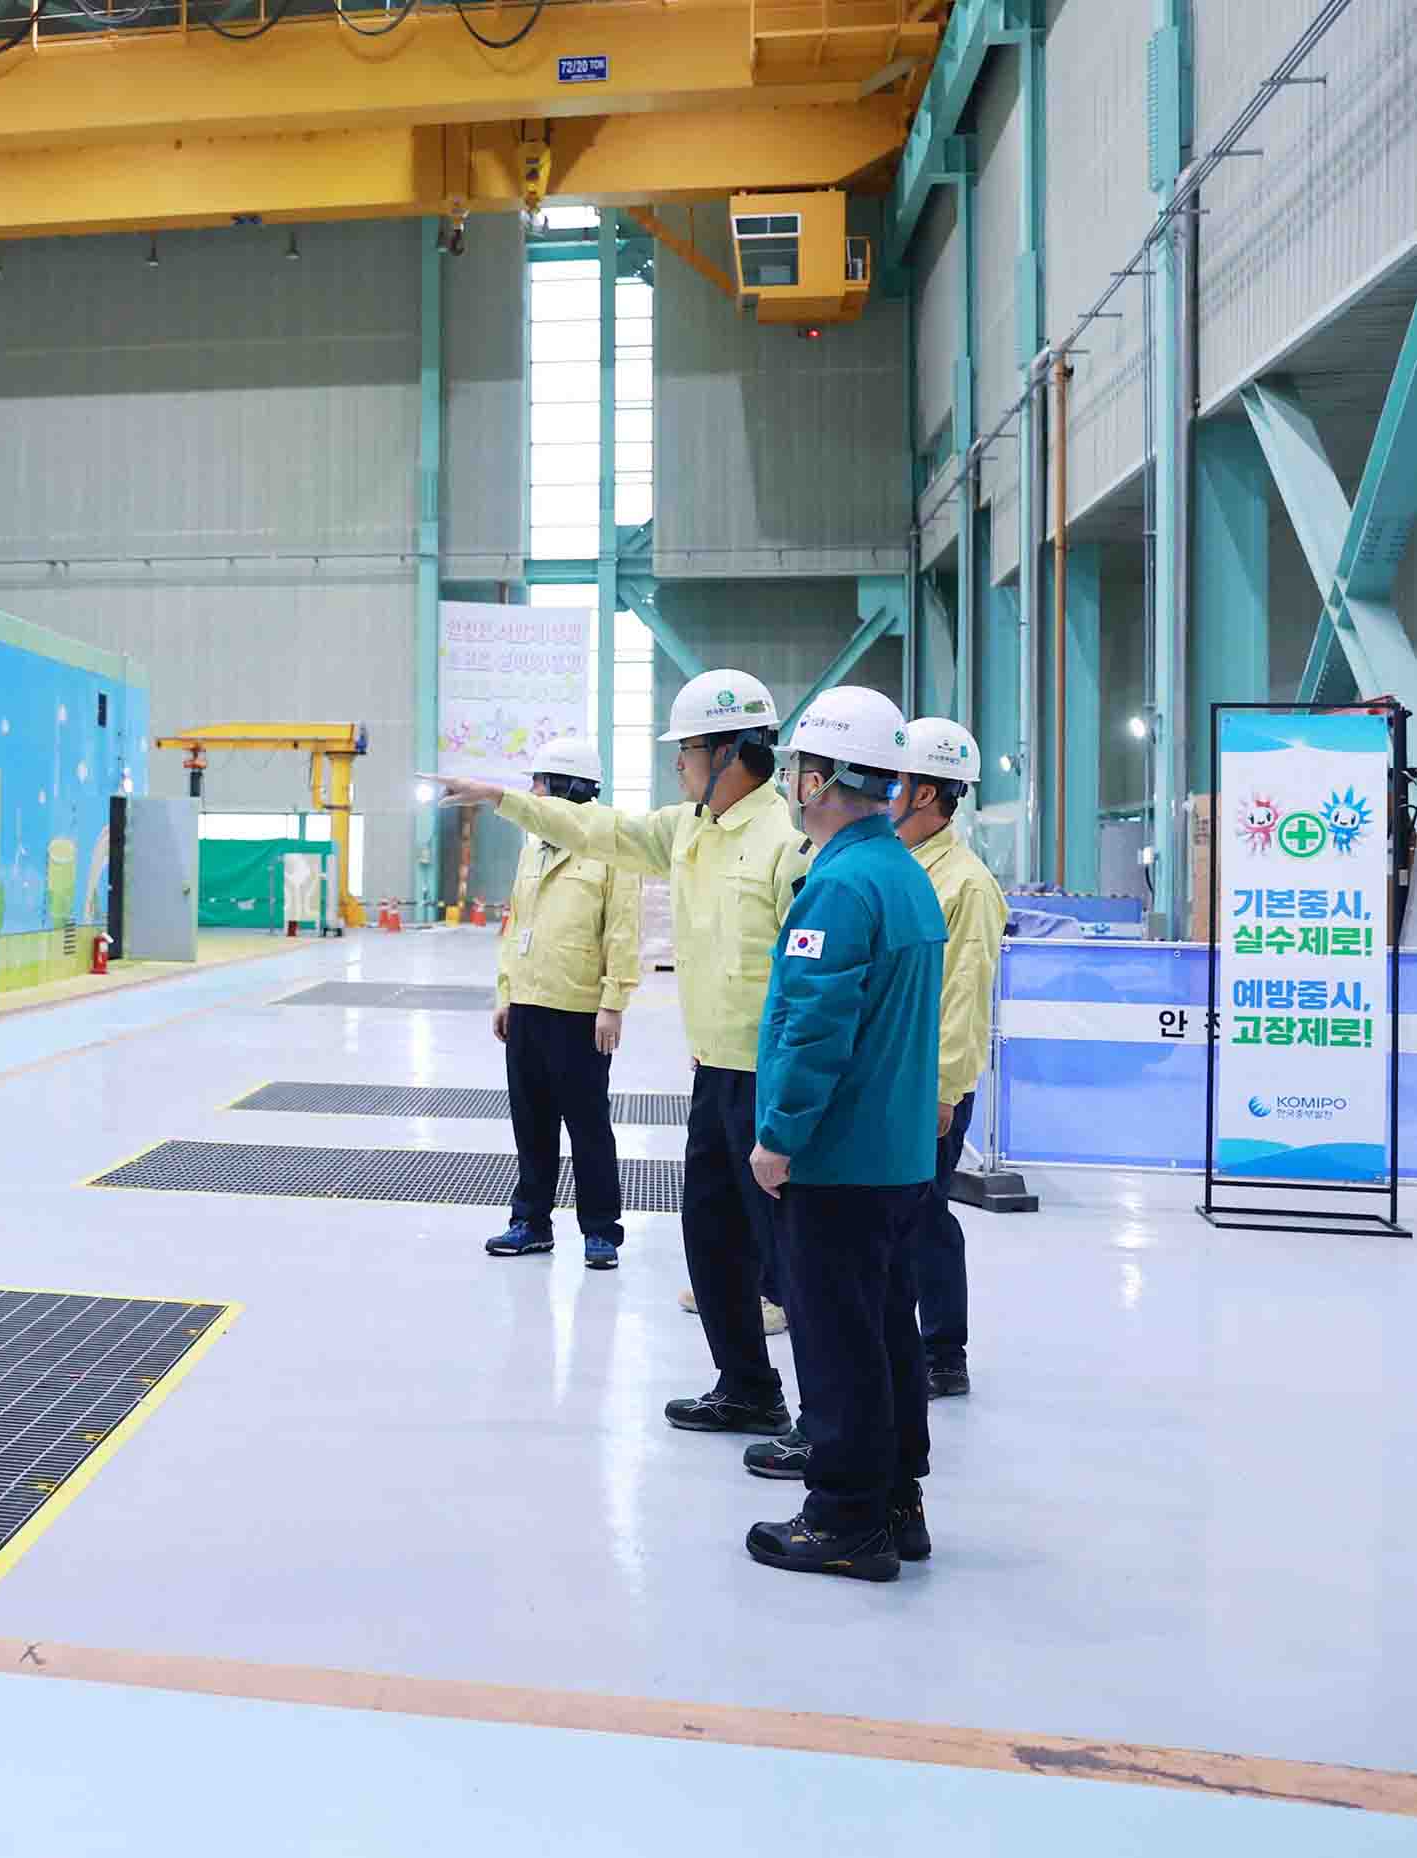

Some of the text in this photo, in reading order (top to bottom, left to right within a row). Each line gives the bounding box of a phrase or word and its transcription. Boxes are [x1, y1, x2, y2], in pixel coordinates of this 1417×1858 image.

[560, 59, 588, 74] 72/20
[1233, 889, 1372, 920] 기본중시,
[1233, 925, 1373, 956] 실수제로!
[1233, 979, 1371, 1012] 예방중시,
[1232, 1016, 1373, 1048] 고장제로!
[1277, 1096, 1347, 1110] KOMIPO
